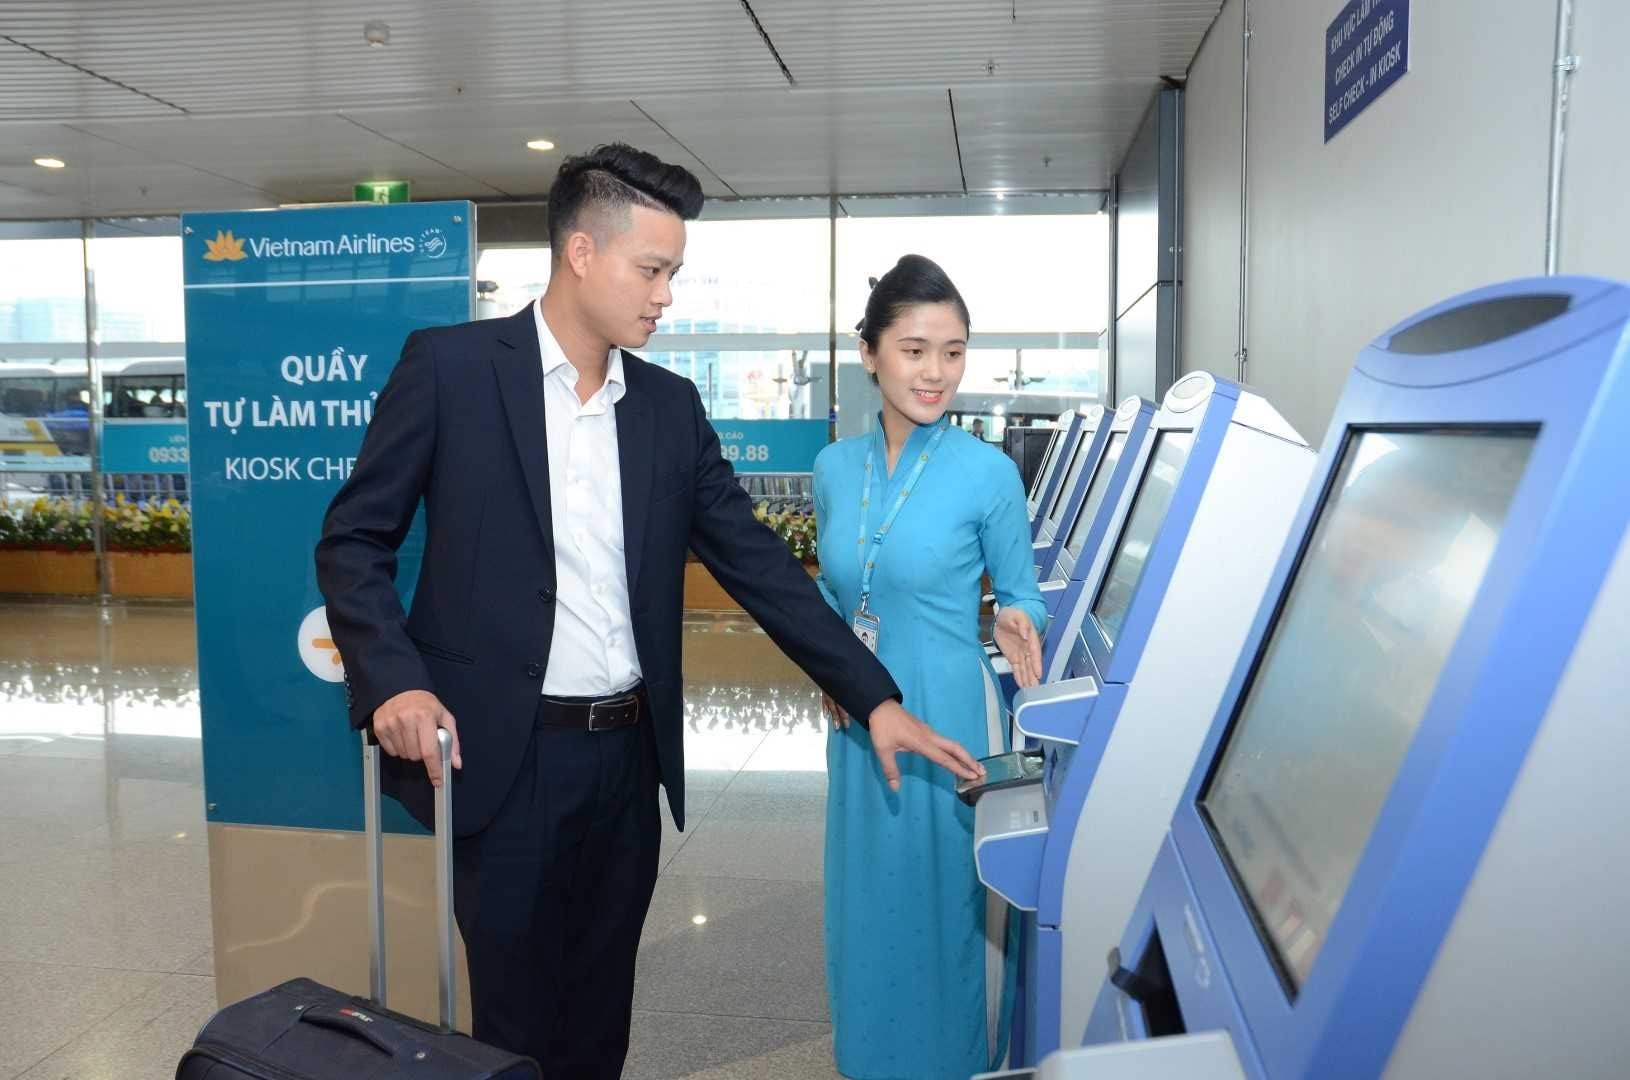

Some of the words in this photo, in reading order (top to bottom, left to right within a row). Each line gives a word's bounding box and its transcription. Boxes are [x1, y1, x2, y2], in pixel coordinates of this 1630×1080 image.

[1328, 97, 1343, 124] SELF
[1343, 77, 1365, 110] CHECK
[1370, 63, 1377, 87] IN
[1379, 40, 1401, 78] KIOSK
[1335, 50, 1355, 86] CHECK
[1355, 42, 1363, 63] IN
[250, 237, 335, 258] Vietnam
[337, 233, 414, 255] Airlines
[280, 346, 368, 386] QUẦY
[204, 397, 247, 435] TỰ
[252, 394, 316, 427] LÀM
[225, 456, 302, 480] KIOSK
